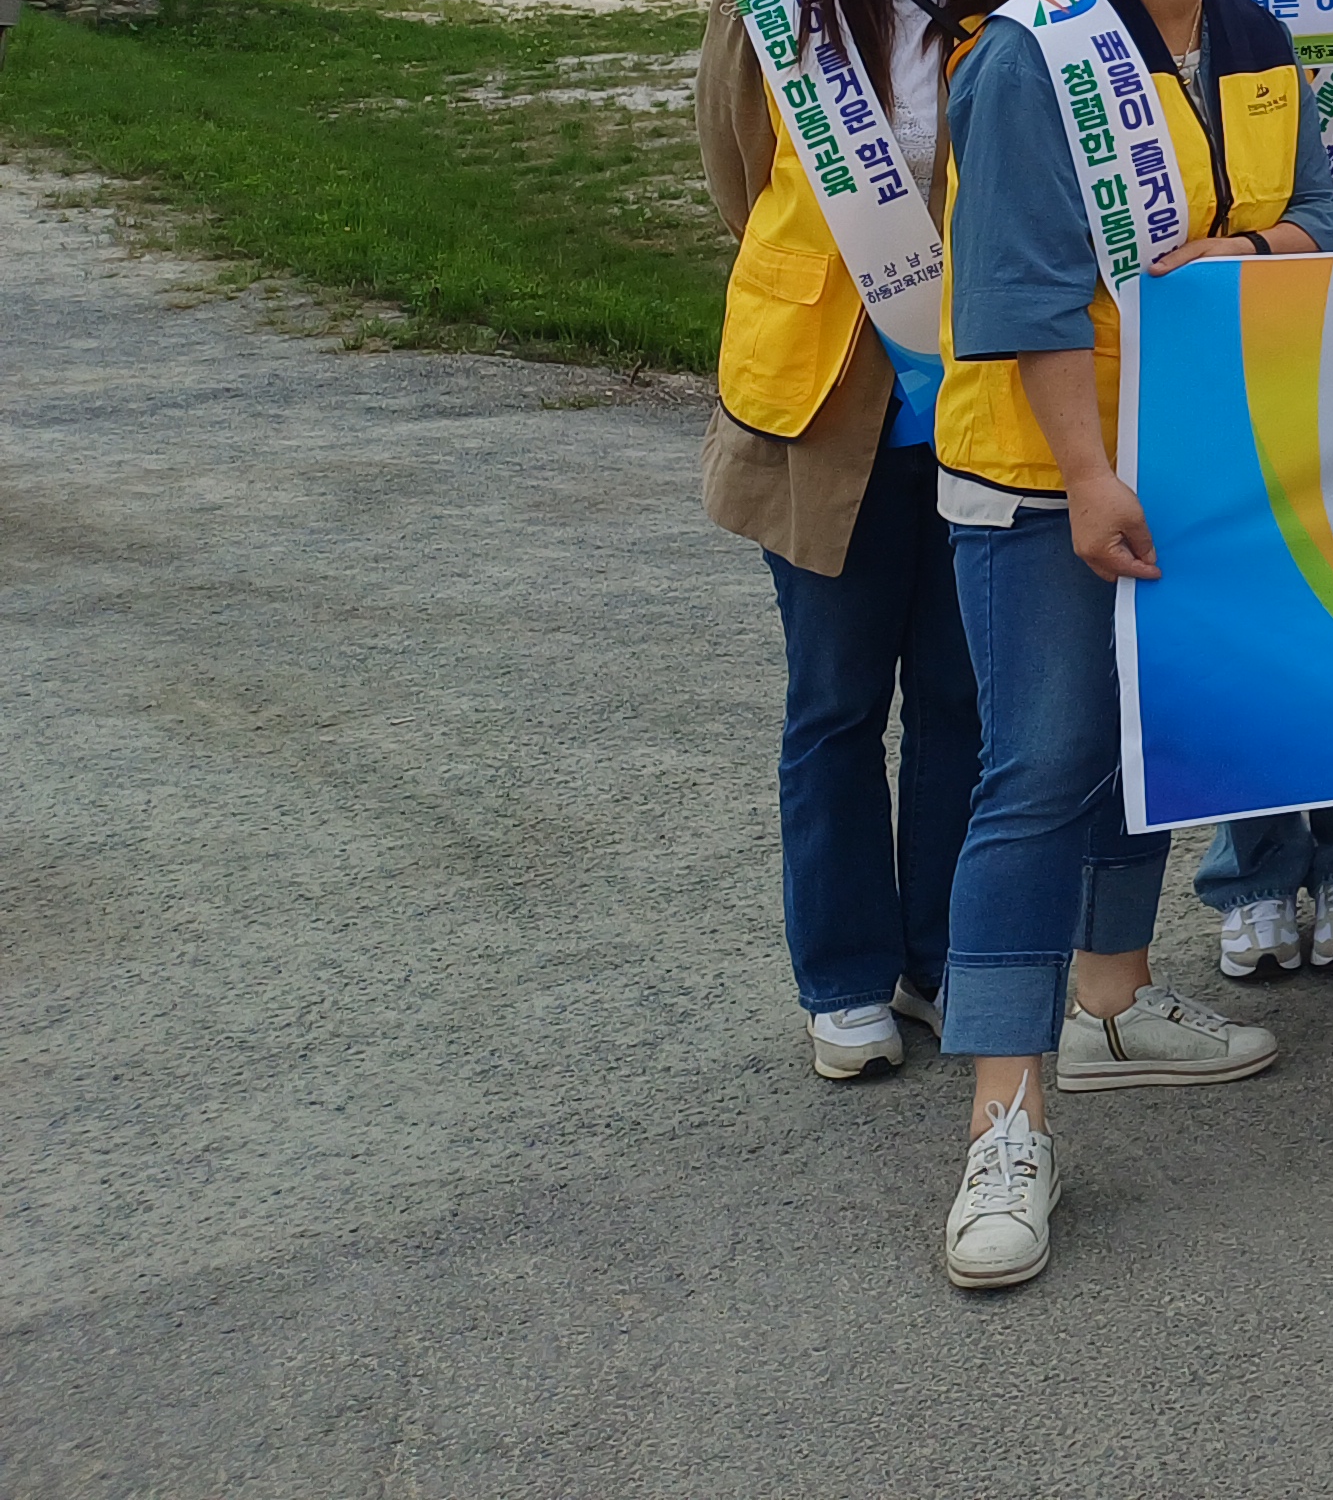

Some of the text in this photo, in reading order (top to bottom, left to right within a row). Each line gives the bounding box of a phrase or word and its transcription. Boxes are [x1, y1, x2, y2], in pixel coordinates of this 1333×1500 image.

[781, 72, 859, 198] 하동교육
[854, 136, 909, 206] 학교
[1059, 58, 1118, 168] 청렴한
[1090, 29, 1180, 244] 배움이 즐거운
